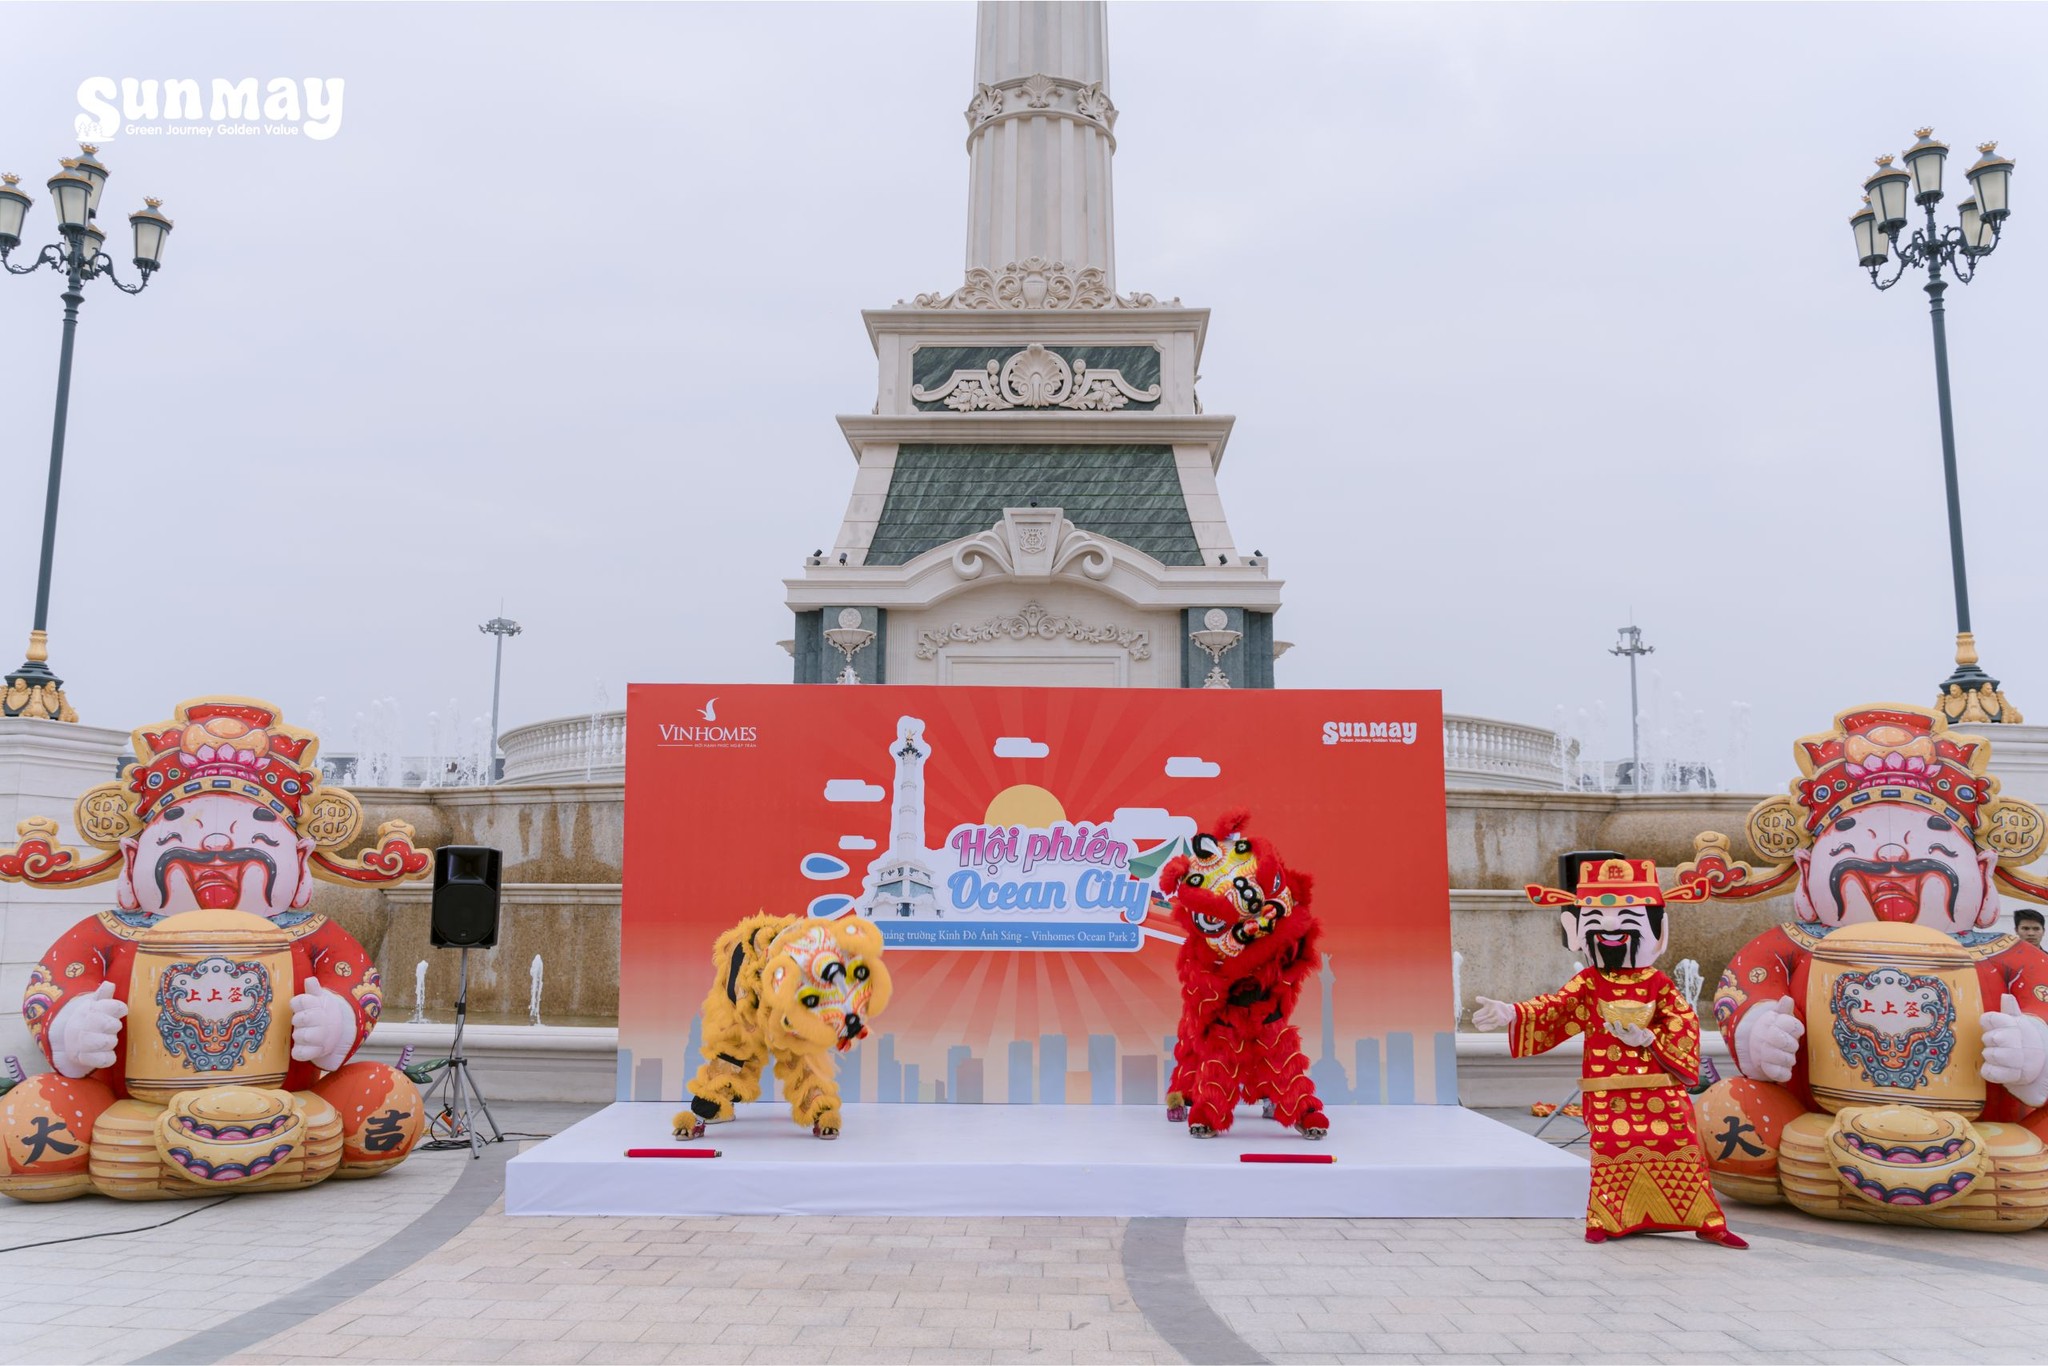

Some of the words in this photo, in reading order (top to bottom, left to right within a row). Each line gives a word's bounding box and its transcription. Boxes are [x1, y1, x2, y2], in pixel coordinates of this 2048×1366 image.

[658, 724, 757, 741] VINHOMES
[952, 827, 1018, 875] Hội
[1022, 827, 1128, 873] phiên
[947, 869, 1067, 910] Ocean
[1075, 868, 1150, 922] City
[880, 929, 905, 942] uảng
[939, 929, 961, 940] Kinh
[963, 929, 977, 940] Đô
[979, 928, 999, 940] Ánh
[1000, 929, 1022, 943] Sáng
[1031, 930, 1075, 941] Vinhomes
[1077, 930, 1106, 942] Ocean
[1108, 931, 1128, 942] Park
[1130, 932, 1136, 942] 2
[185, 986, 243, 1003] 上上签
[1859, 999, 1920, 1018] 上上签
[21, 1116, 80, 1166] 大
[365, 1109, 411, 1151] 吉
[1715, 1115, 1767, 1161] 大
